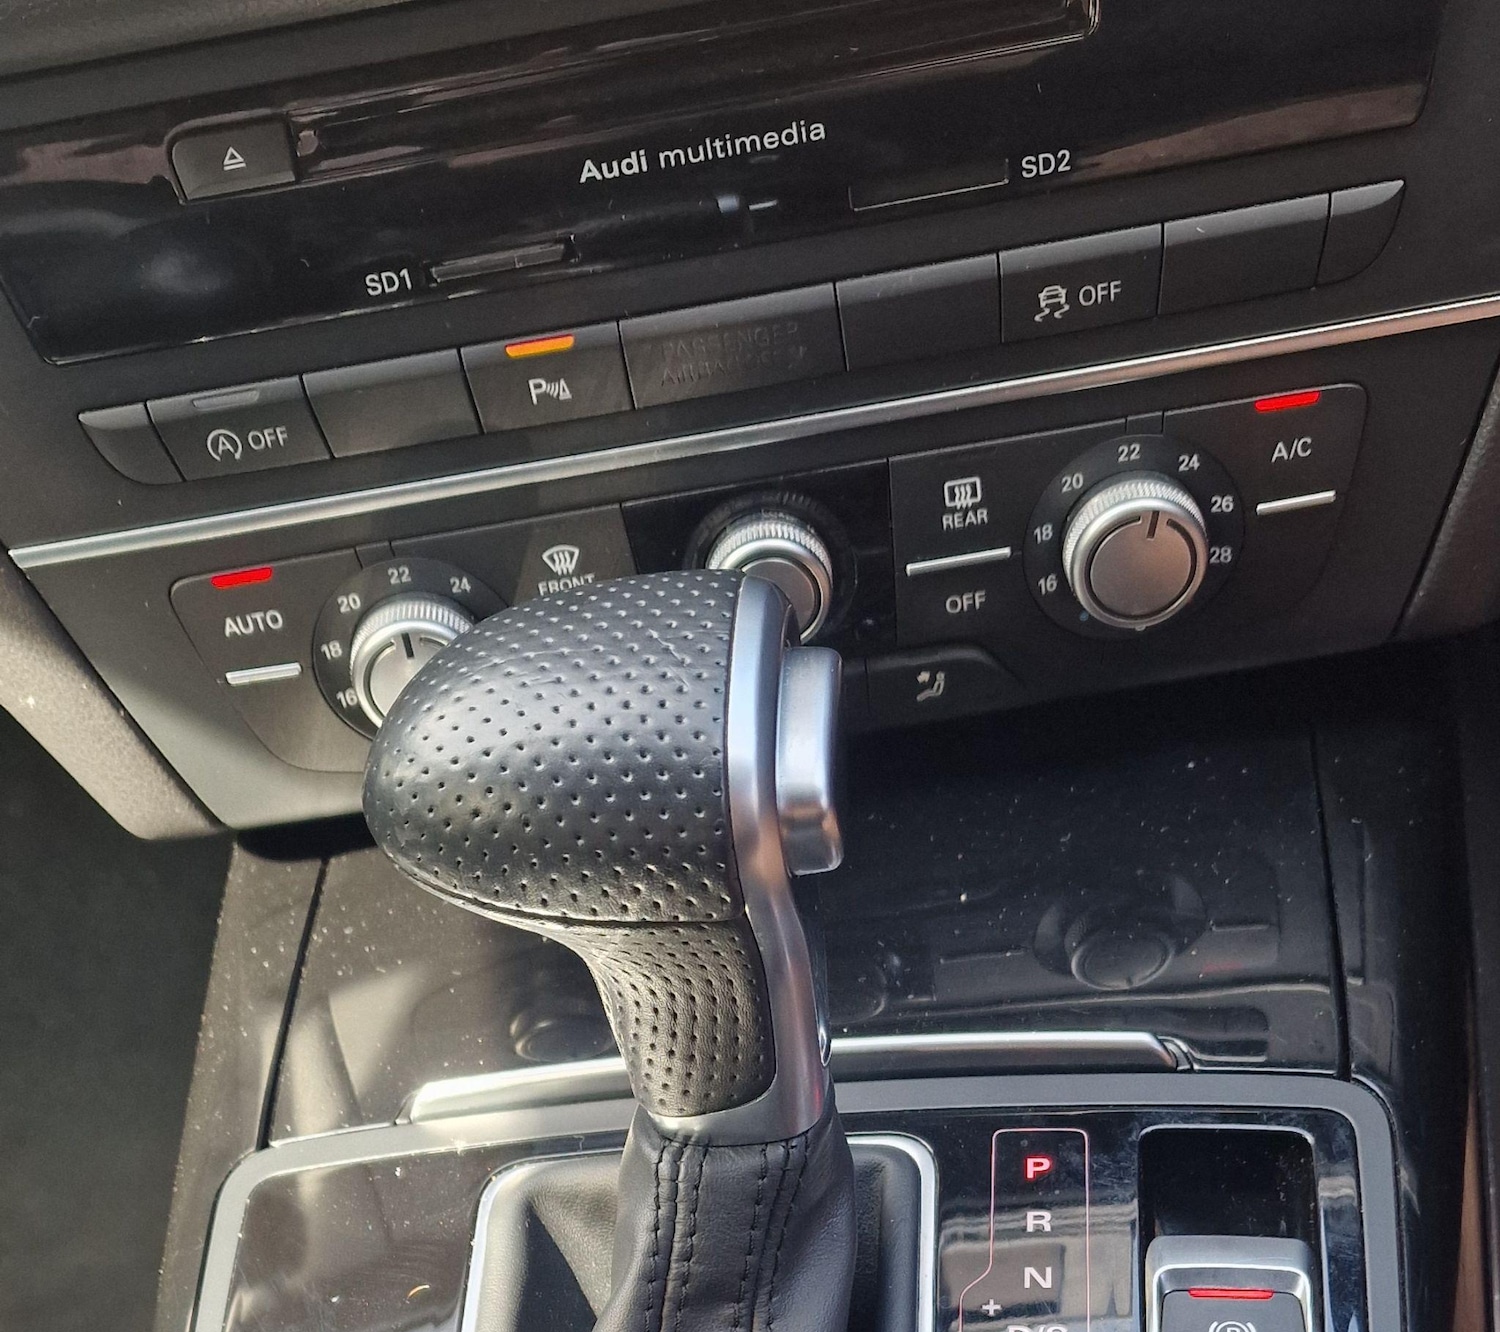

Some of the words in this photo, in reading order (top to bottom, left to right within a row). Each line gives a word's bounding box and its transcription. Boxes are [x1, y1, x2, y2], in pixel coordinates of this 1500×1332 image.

[579, 149, 648, 184] Audi
[658, 119, 827, 169] multimedia
[1021, 149, 1071, 178] SD2
[365, 268, 412, 296] SD1
[1078, 280, 1121, 306] OFF
[247, 426, 288, 450] OFF
[1118, 443, 1140, 463] 22
[1271, 437, 1312, 463] A/C
[1178, 453, 1200, 472] 24
[1061, 472, 1084, 493] 20
[1211, 495, 1234, 513] 26
[942, 508, 988, 531] REAR
[1033, 523, 1053, 544] 18
[1209, 546, 1232, 564] 28
[387, 566, 412, 585] 22
[449, 576, 472, 594] 24
[538, 573, 595, 596] FRONT
[1038, 574, 1058, 595] 16
[337, 593, 361, 613] 20
[945, 590, 986, 614] OFF
[224, 609, 283, 637] AUTO
[321, 640, 343, 660] 18
[336, 688, 358, 709] 16
[1026, 1157, 1051, 1179] P
[1026, 1210, 1052, 1233] R
[1024, 1266, 1052, 1289] N
